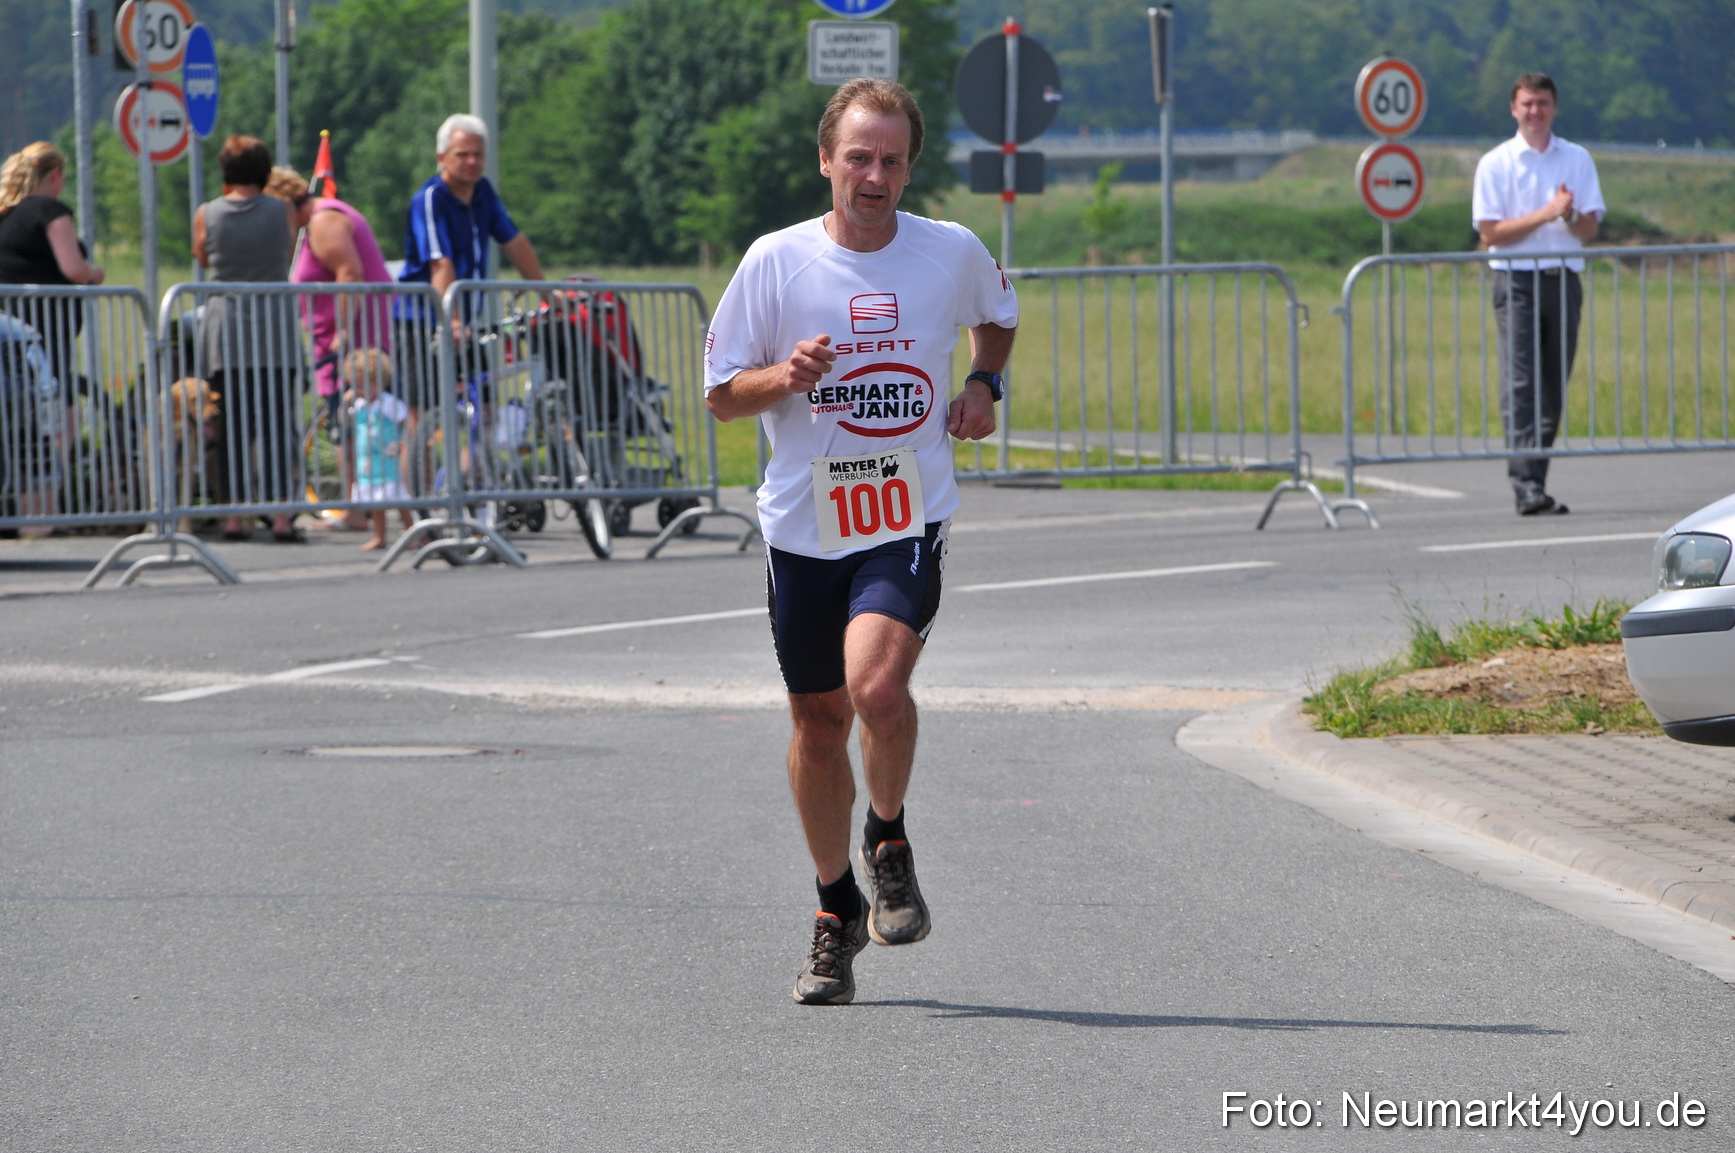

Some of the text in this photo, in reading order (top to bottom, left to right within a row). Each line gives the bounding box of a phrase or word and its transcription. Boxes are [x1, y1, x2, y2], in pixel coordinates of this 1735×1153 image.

[1374, 80, 1410, 115] 60
[836, 339, 916, 356] SEAT
[811, 402, 855, 414] AUTOHAUS
[851, 400, 925, 420] JÄNIG
[829, 458, 878, 474] MEYER
[829, 469, 879, 482] WERBUNG
[829, 478, 912, 538] 100
